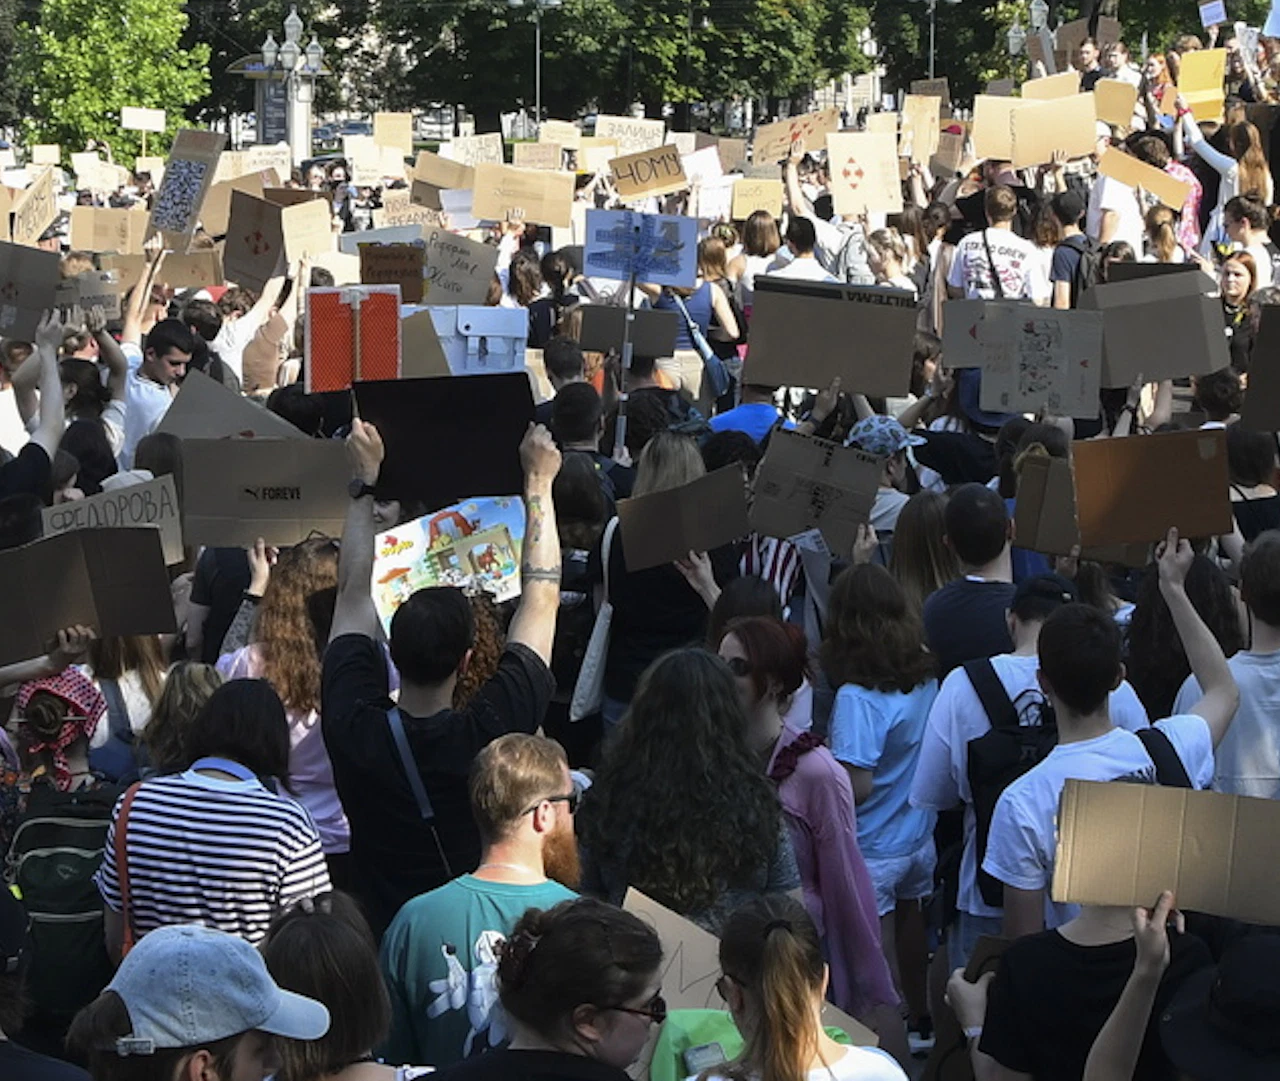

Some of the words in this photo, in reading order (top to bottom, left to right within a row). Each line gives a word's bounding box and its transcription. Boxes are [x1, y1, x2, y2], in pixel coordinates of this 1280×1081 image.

[615, 152, 682, 187] ЧОМУ
[965, 241, 997, 254] STATC
[997, 246, 1028, 261] CREW
[50, 485, 175, 530] ФЕДОРОВА
